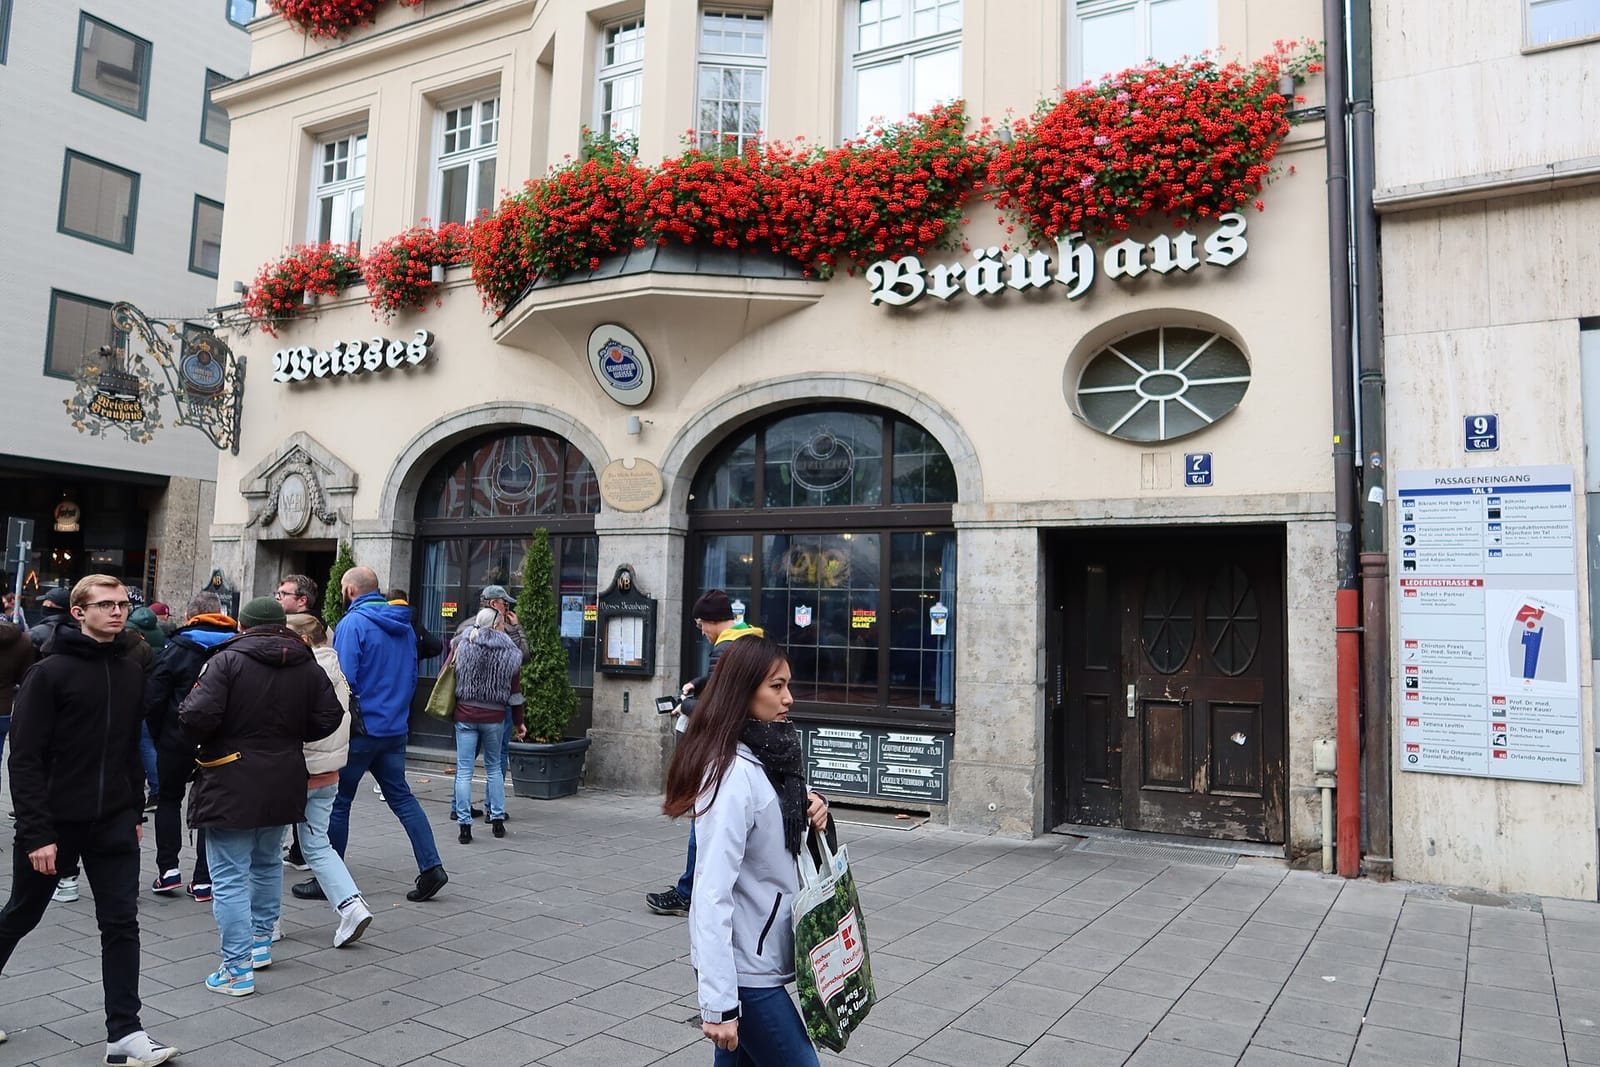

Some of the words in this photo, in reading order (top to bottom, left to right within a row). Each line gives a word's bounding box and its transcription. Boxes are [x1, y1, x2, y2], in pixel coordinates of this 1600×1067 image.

[865, 212, 1249, 307] Bräuhaus
[272, 329, 430, 383] Weisses
[1474, 417, 1488, 434] 9
[1474, 439, 1490, 448] Tal
[1192, 456, 1204, 470] 7
[1192, 475, 1205, 483] Tal
[1434, 474, 1530, 484] PASSAGENEINGANG
[797, 616, 808, 624] NFL
